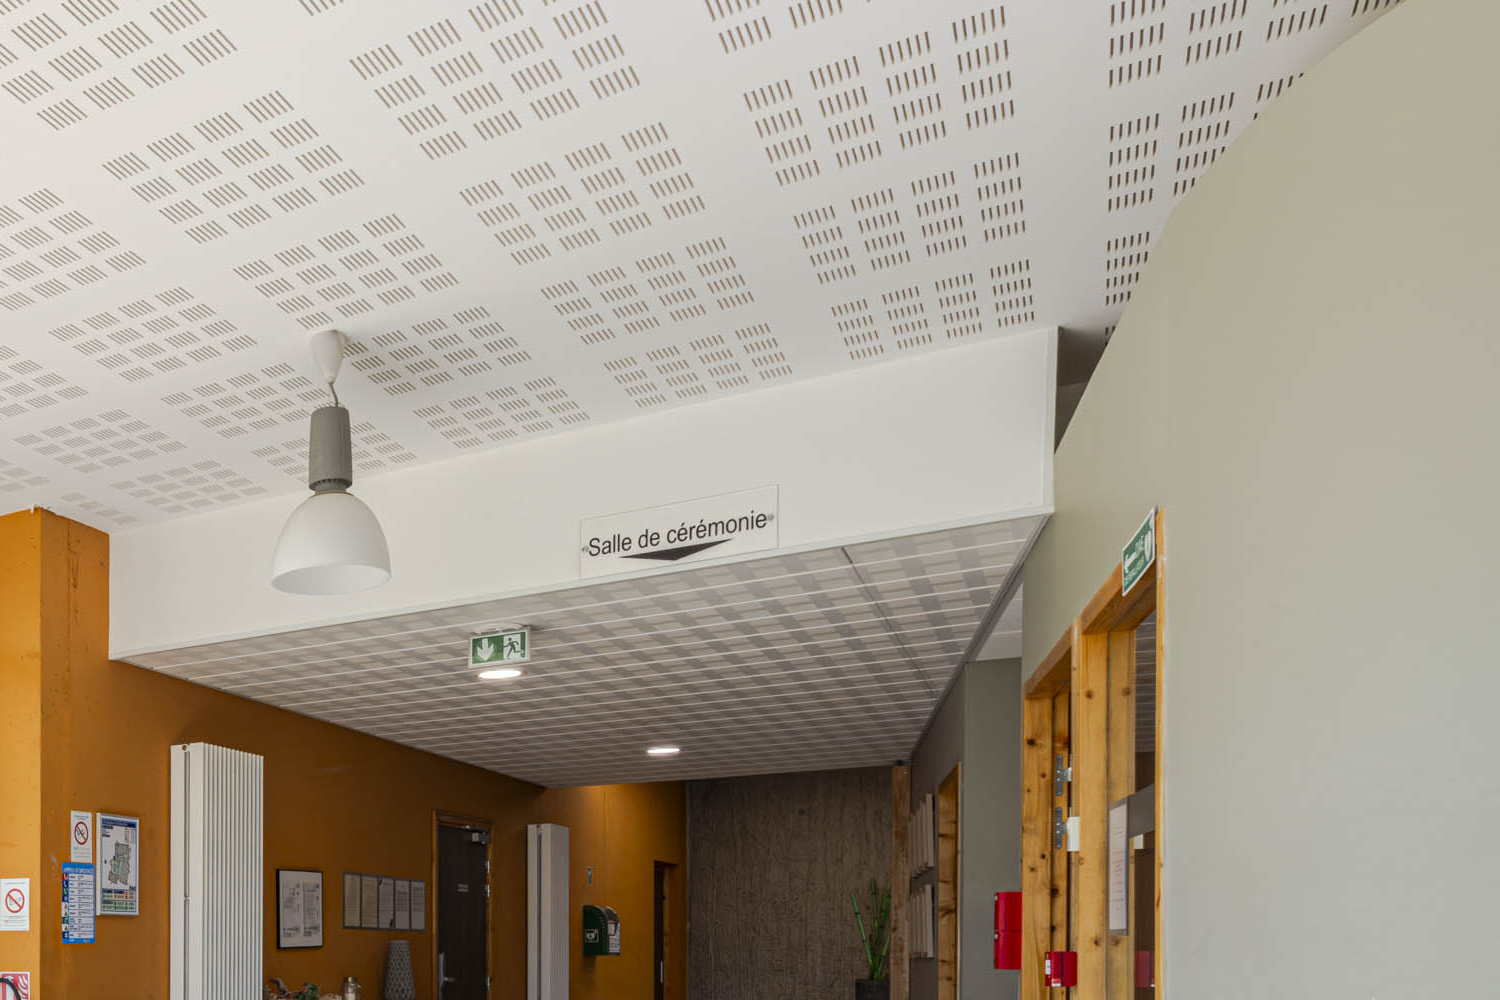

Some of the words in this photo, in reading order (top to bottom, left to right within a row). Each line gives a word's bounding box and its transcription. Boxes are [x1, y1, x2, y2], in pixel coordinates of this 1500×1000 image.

[588, 534, 633, 557] Salle
[637, 529, 661, 549] de
[666, 510, 768, 544] cérémonie
